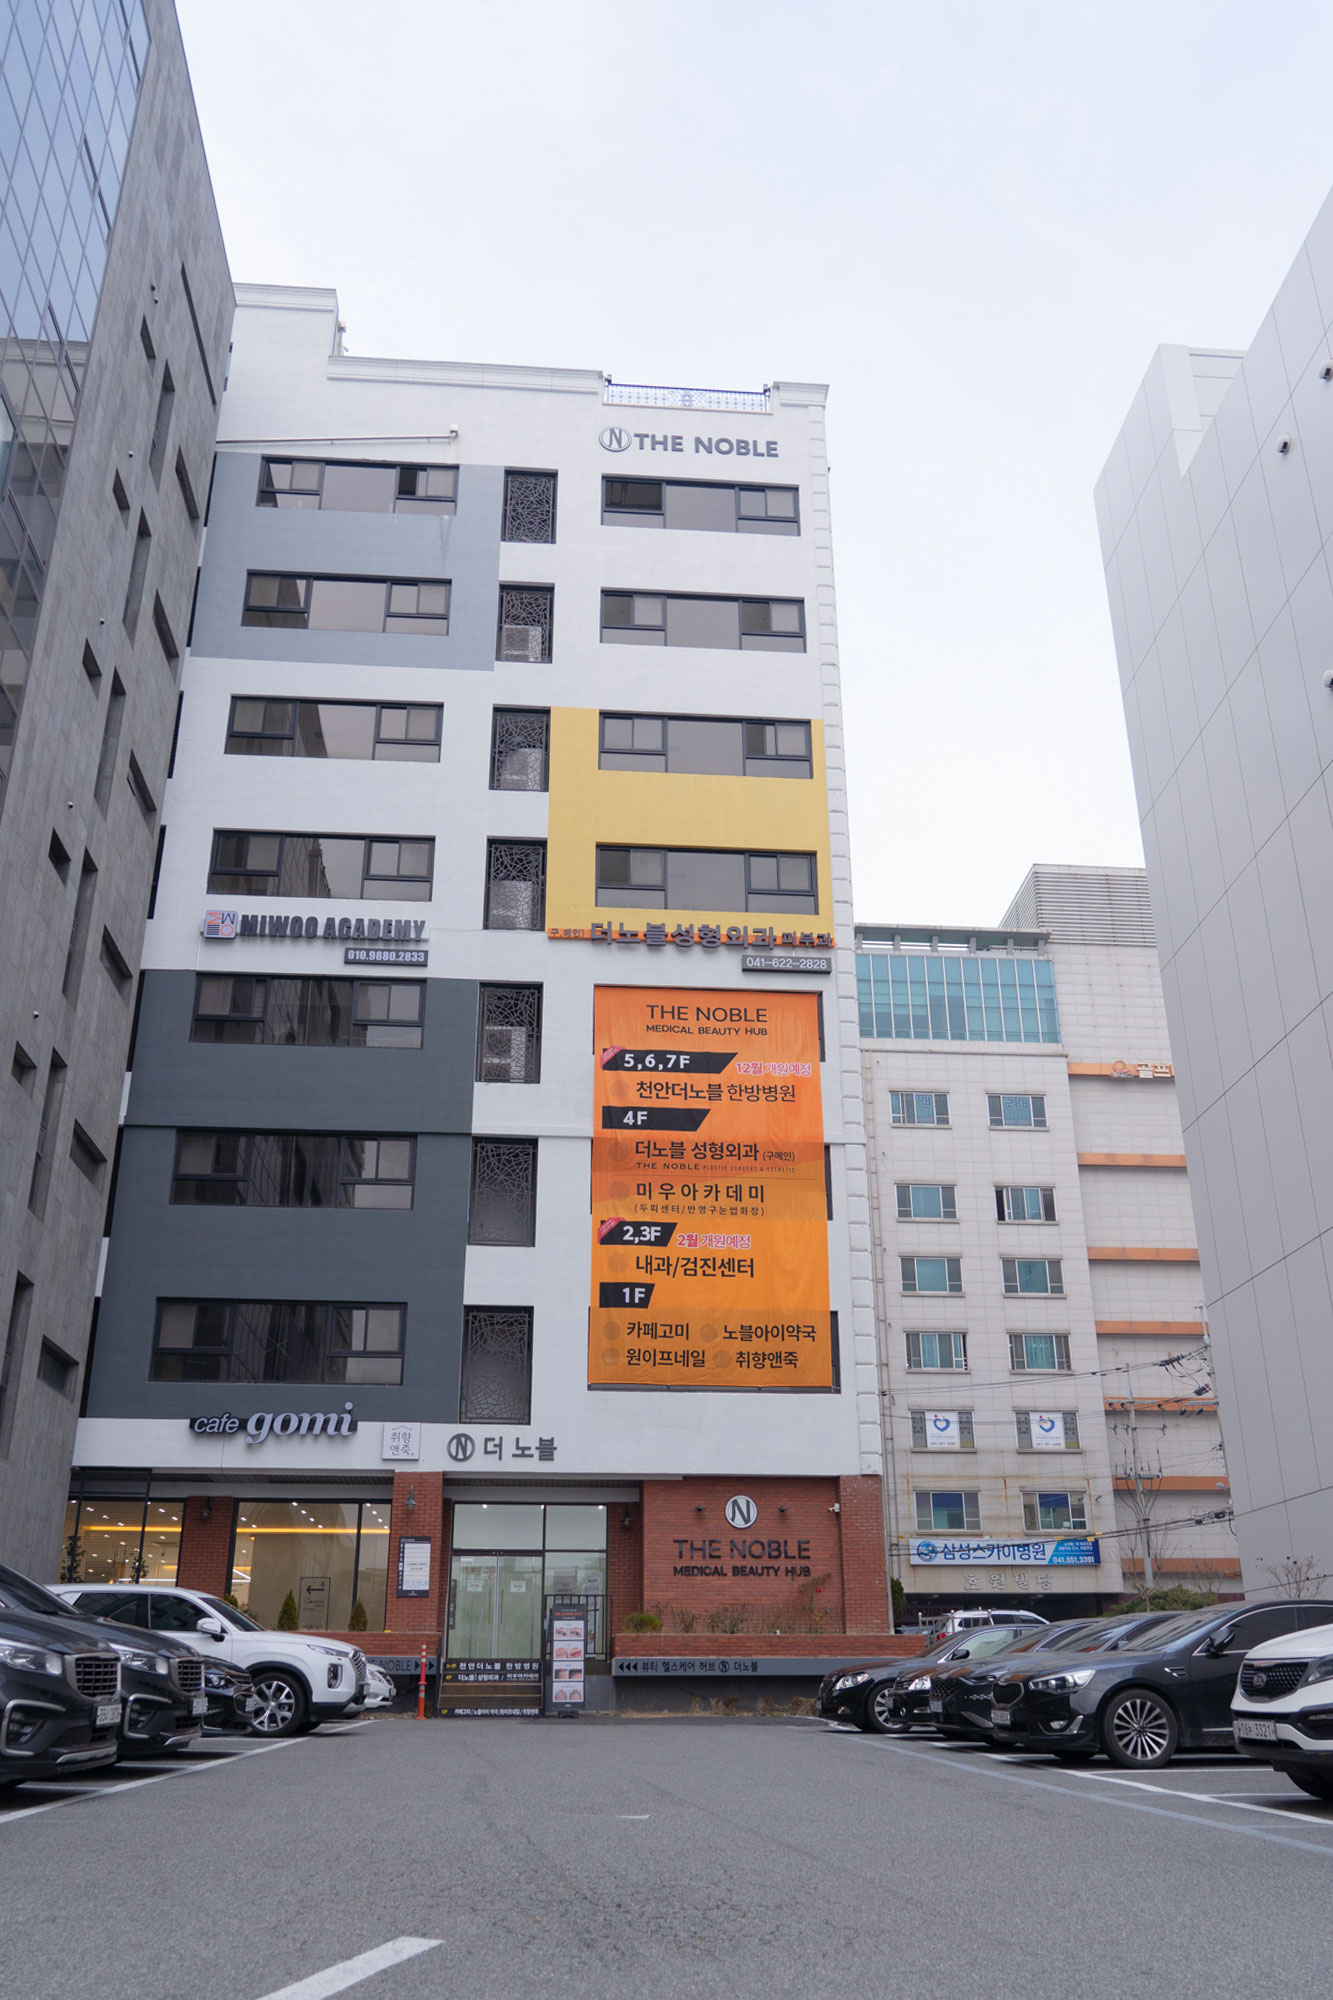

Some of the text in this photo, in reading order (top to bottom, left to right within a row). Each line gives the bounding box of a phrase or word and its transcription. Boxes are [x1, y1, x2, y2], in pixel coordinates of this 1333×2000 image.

[633, 432, 684, 452] THE
[694, 437, 779, 457] NOBLE
[240, 914, 318, 938] MIWOO
[323, 917, 426, 941] ACADEMY
[590, 921, 777, 949] 더노블성형외과
[781, 931, 832, 948] 피부과
[347, 950, 425, 962] 010.9880.2833
[746, 957, 827, 969] 041-622-2828
[646, 1005, 768, 1023] THE NOBLE
[646, 1024, 768, 1036] MEDICAL BEAUTY HUB
[624, 1053, 690, 1070] 5,6,7F
[735, 1062, 812, 1077] 12월 개원예정
[636, 1081, 796, 1103] 천안더노블 한방병원
[623, 1110, 648, 1126] 4F
[635, 1140, 686, 1160] 더노블
[691, 1142, 760, 1162] 성형외과
[636, 1162, 657, 1170] THE
[663, 1163, 701, 1171] NOBLE
[636, 1182, 764, 1203] 미우아카데미
[622, 1225, 662, 1244] 2,3F
[676, 1234, 751, 1249] 2월 개원예정
[635, 1255, 754, 1278] 내과/검진센터
[623, 1288, 646, 1303] 1F
[626, 1322, 817, 1342] 카페고미 노블아이약국
[626, 1349, 799, 1369] 원이프네일 취향앤죽
[193, 1402, 354, 1444] cafe gomi
[673, 1539, 811, 1560] THE NOBLE
[942, 1543, 1047, 1561] 삼성스카이병원
[673, 1566, 811, 1577] MEDICAL BEAUTY HUB
[380, 1660, 411, 1671] NOBLE
[641, 1662, 658, 1672] 뷰티
[662, 1661, 695, 1672] 헬스케어
[699, 1662, 716, 1672] 허브
[734, 1661, 758, 1672] 더노블
